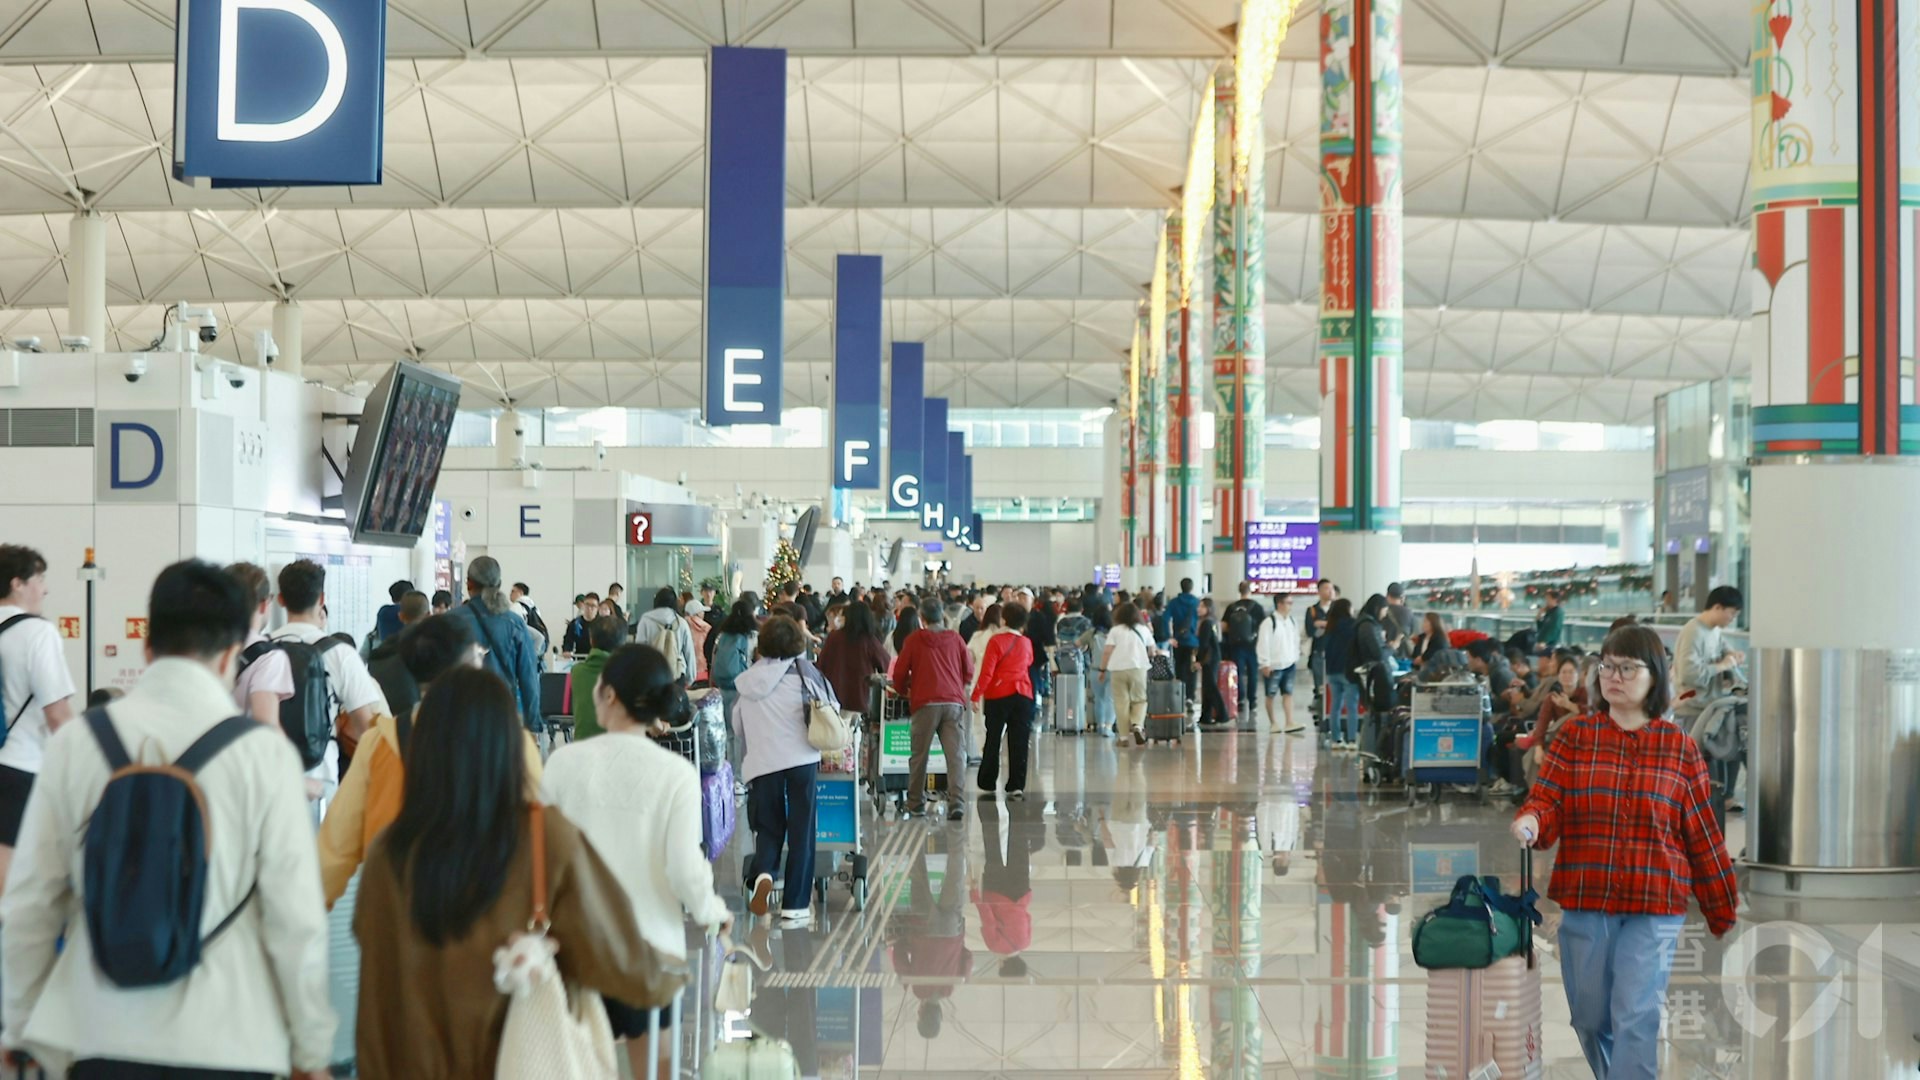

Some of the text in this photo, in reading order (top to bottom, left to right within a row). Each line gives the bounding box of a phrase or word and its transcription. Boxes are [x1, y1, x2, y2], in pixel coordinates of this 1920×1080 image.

[217, 0, 347, 142] D
[723, 348, 764, 412] E
[110, 422, 164, 490] D
[843, 440, 870, 482] F
[892, 474, 920, 507] G
[520, 505, 541, 538] E
[923, 502, 944, 528] H
[946, 516, 960, 539] J
